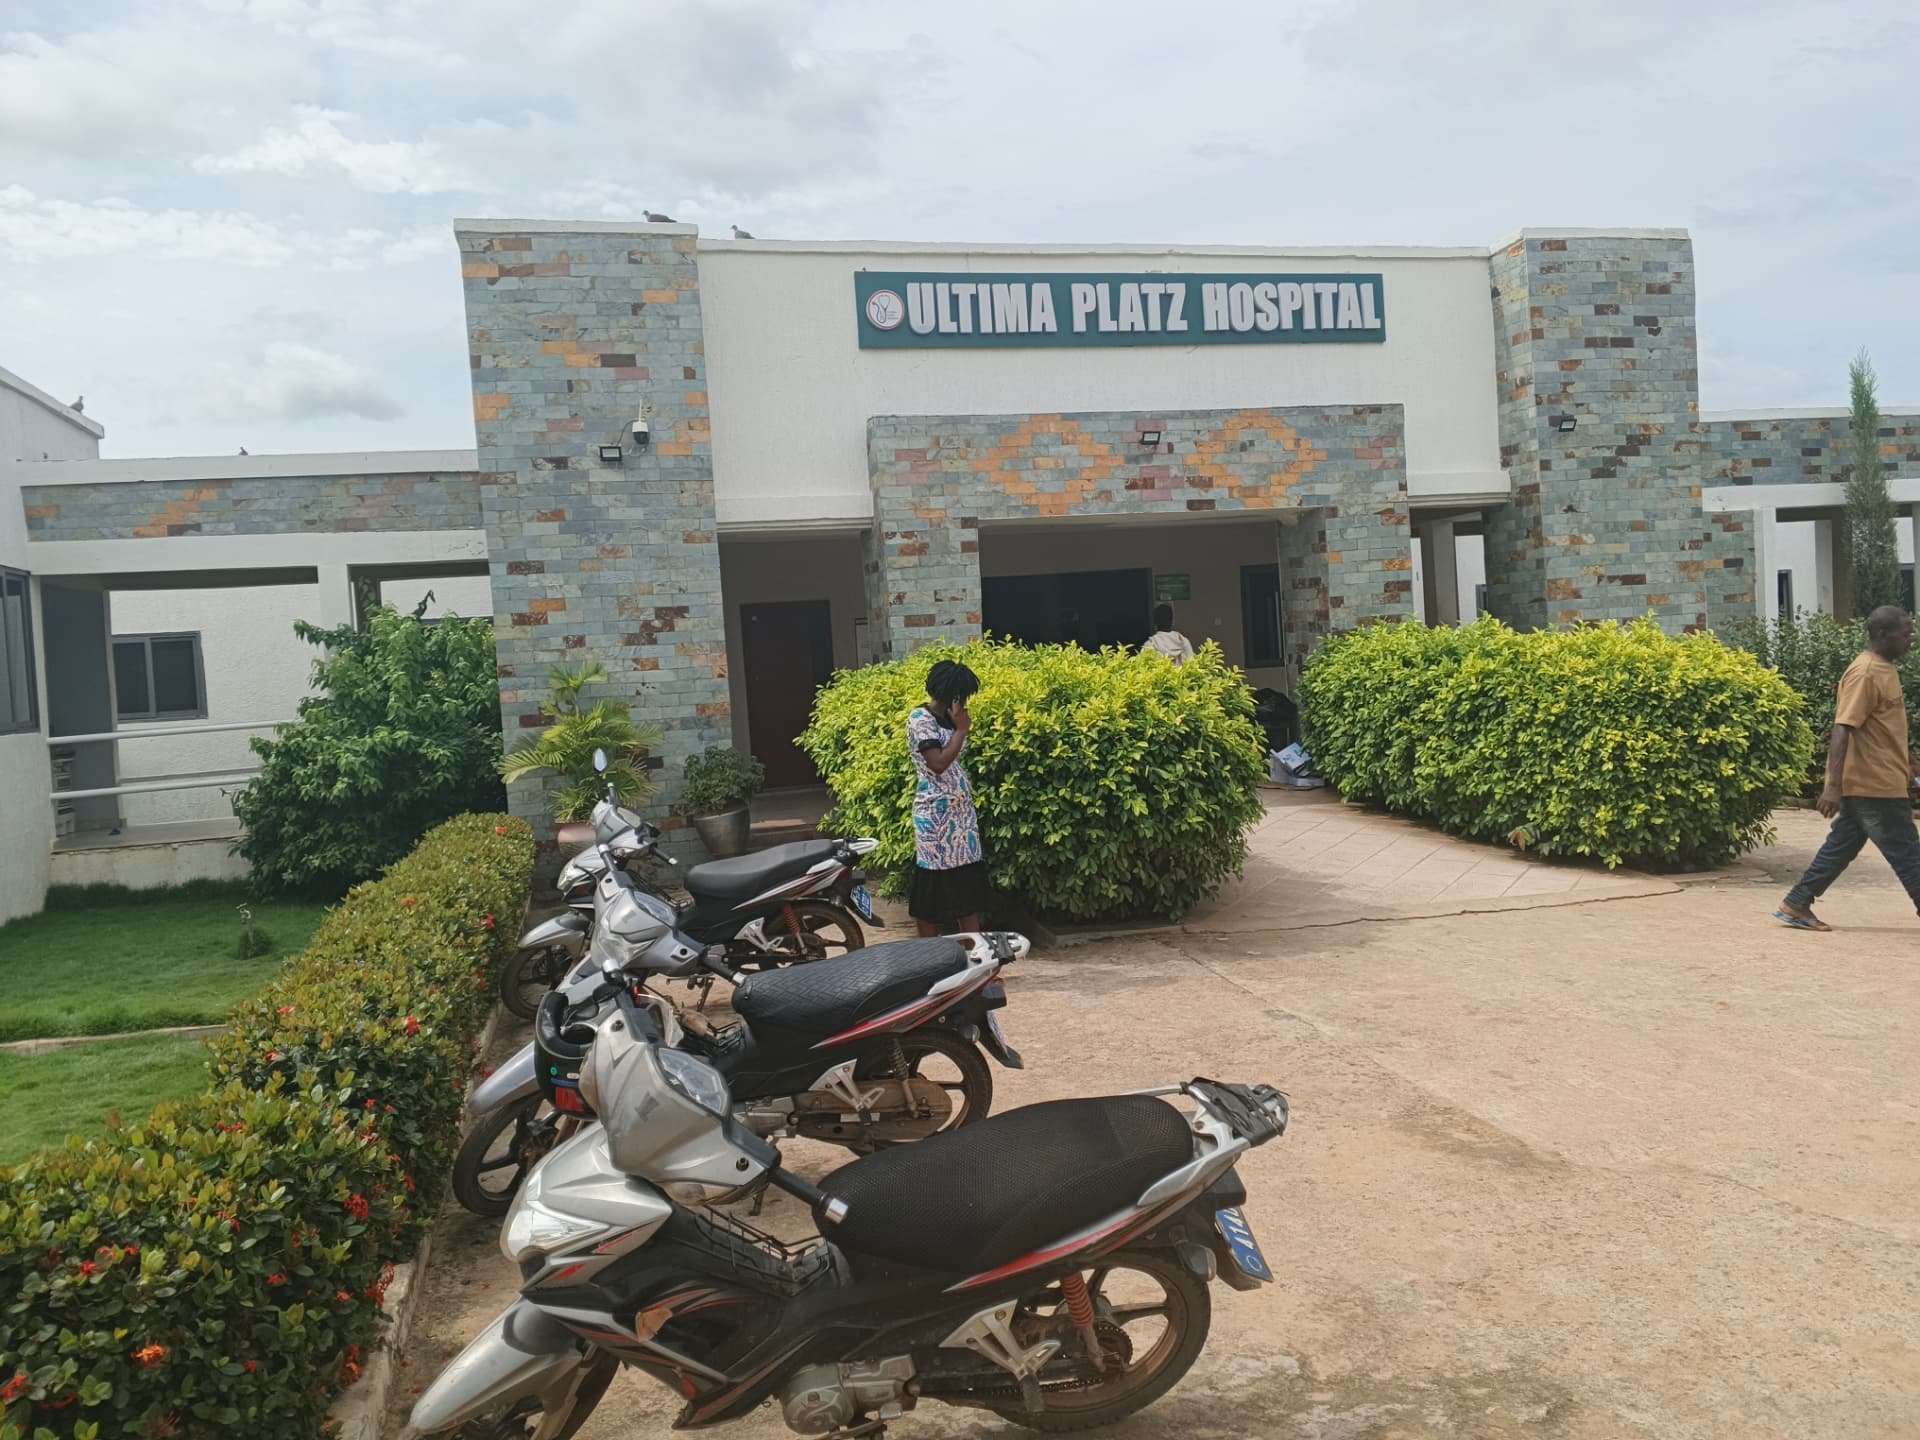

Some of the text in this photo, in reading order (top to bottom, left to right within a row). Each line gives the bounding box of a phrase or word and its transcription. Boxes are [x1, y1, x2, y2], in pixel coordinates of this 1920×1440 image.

[906, 282, 1381, 334] ULTIMA PLATZ HOSPITAL
